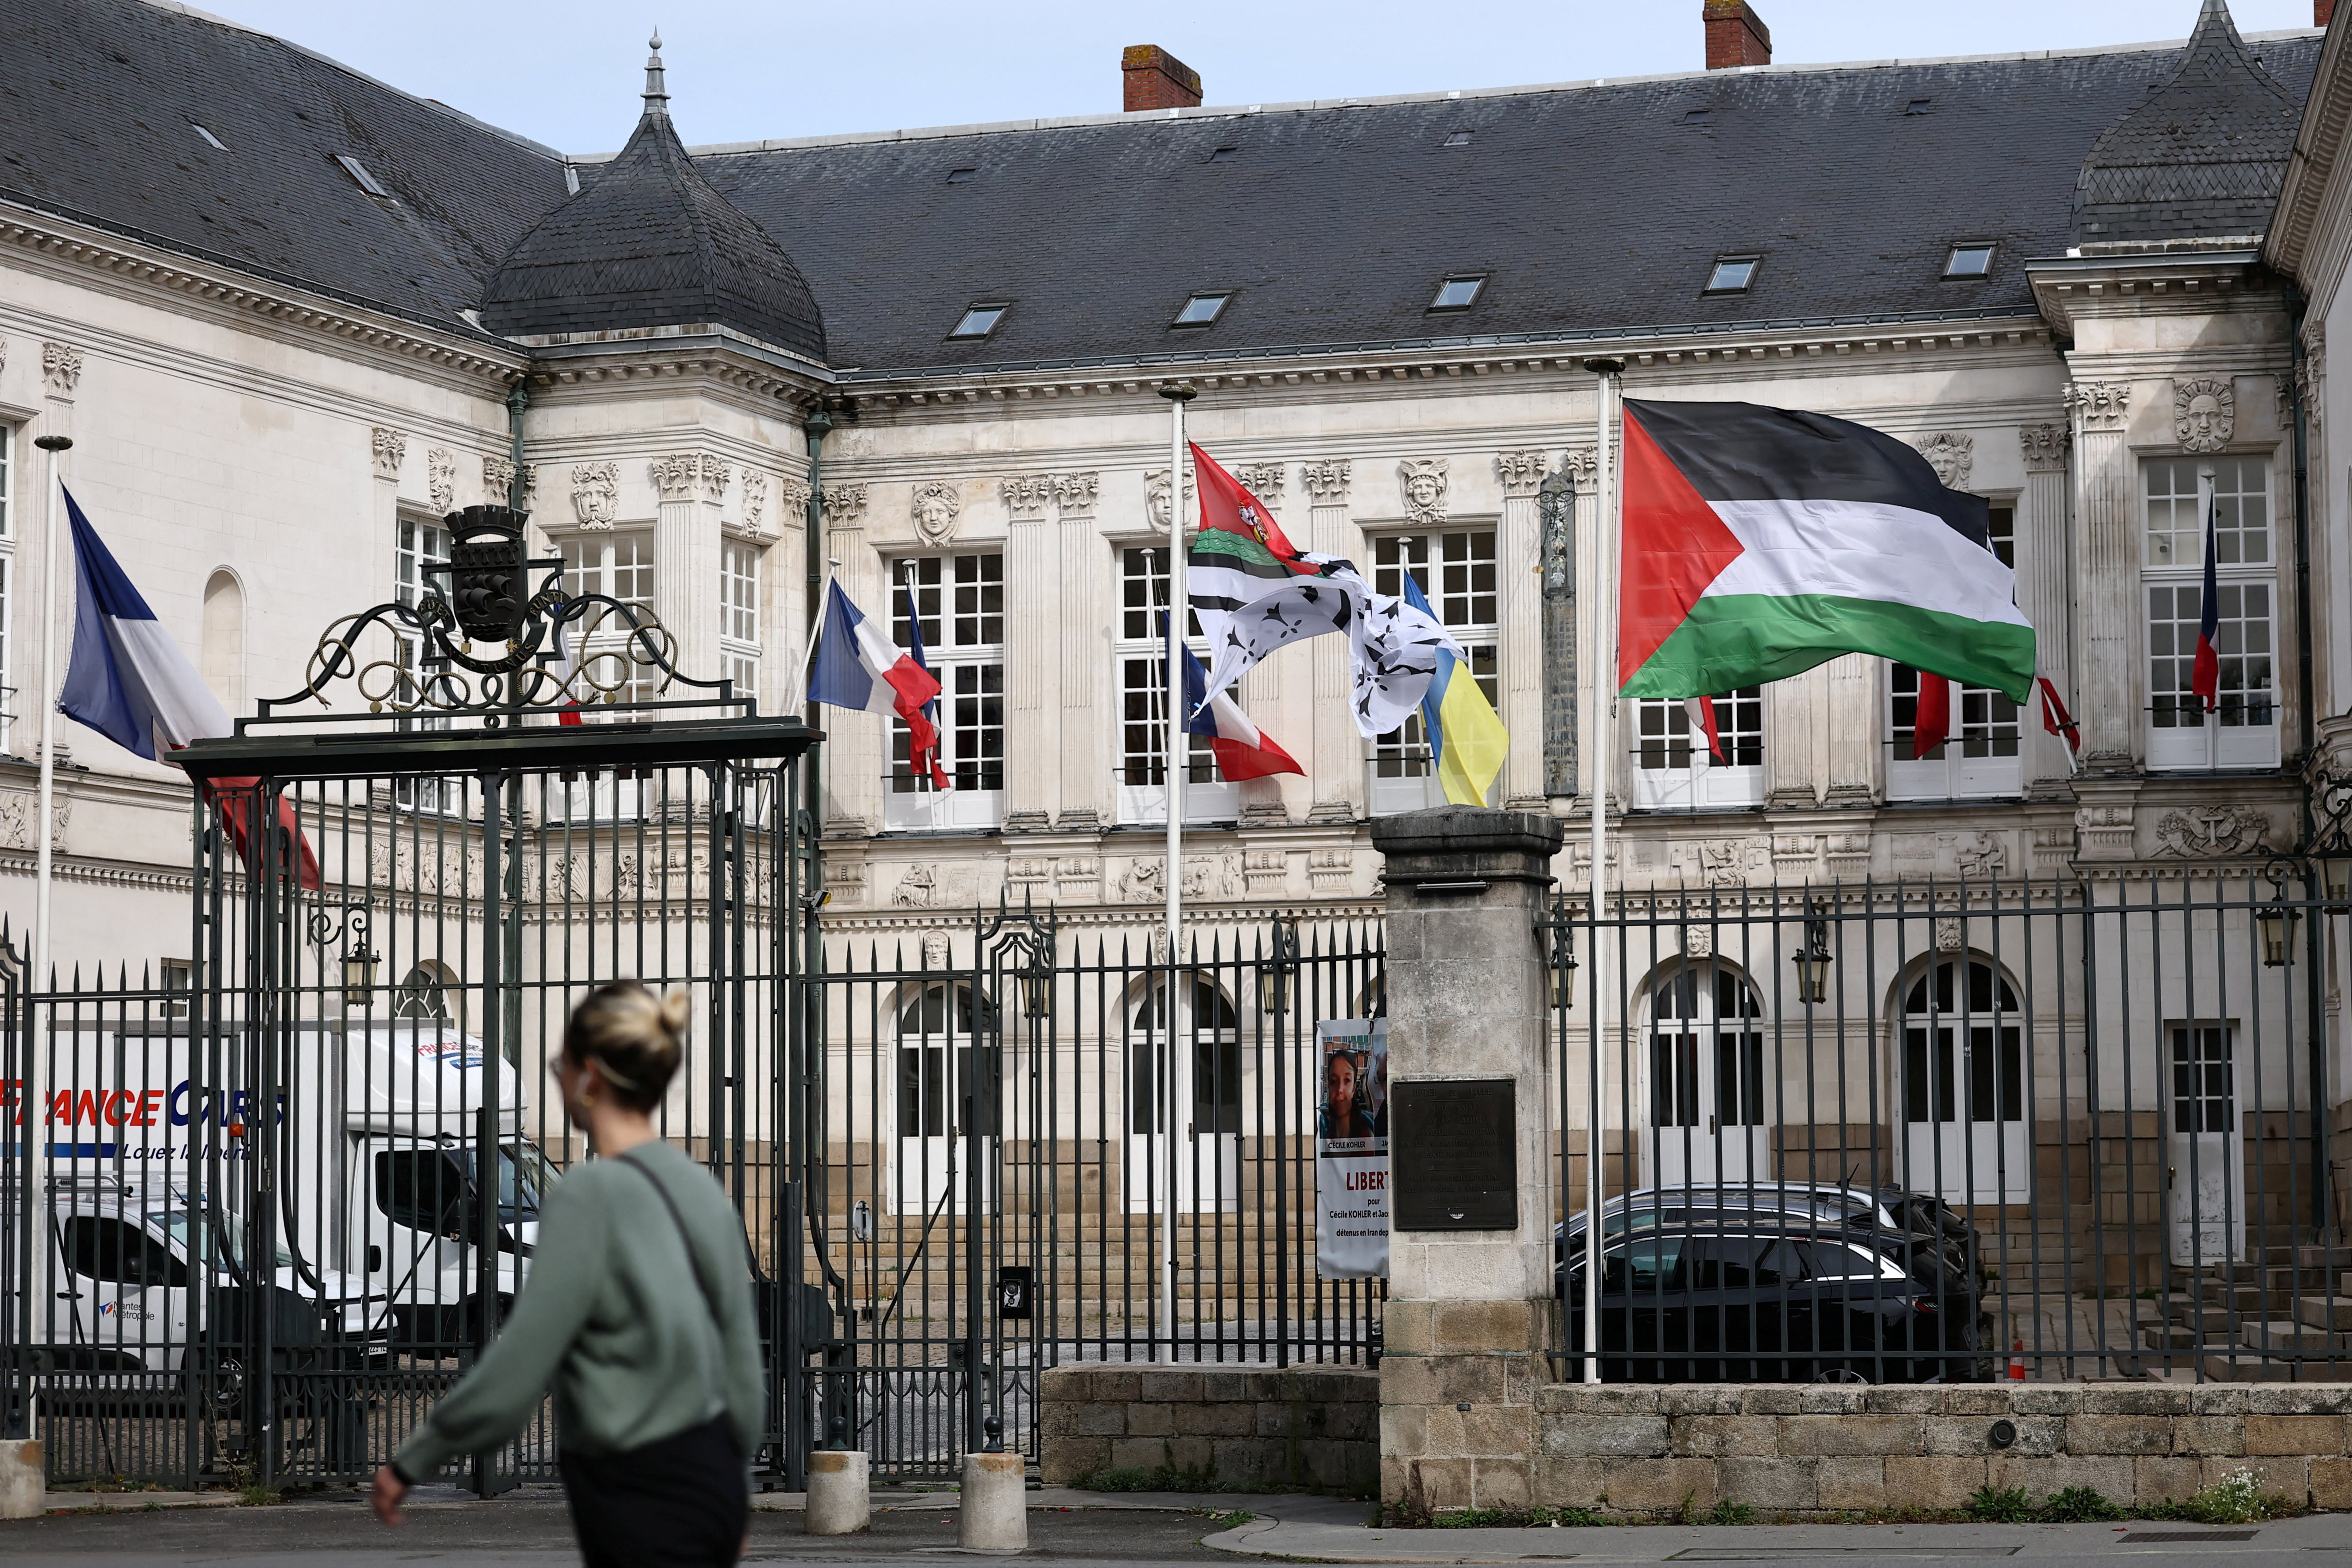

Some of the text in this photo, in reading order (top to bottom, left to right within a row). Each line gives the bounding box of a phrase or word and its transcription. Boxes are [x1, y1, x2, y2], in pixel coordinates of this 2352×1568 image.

[530, 592, 563, 617] EUNTI
[0, 1079, 282, 1128] ANCE CAR
[123, 1144, 176, 1159] Louez
